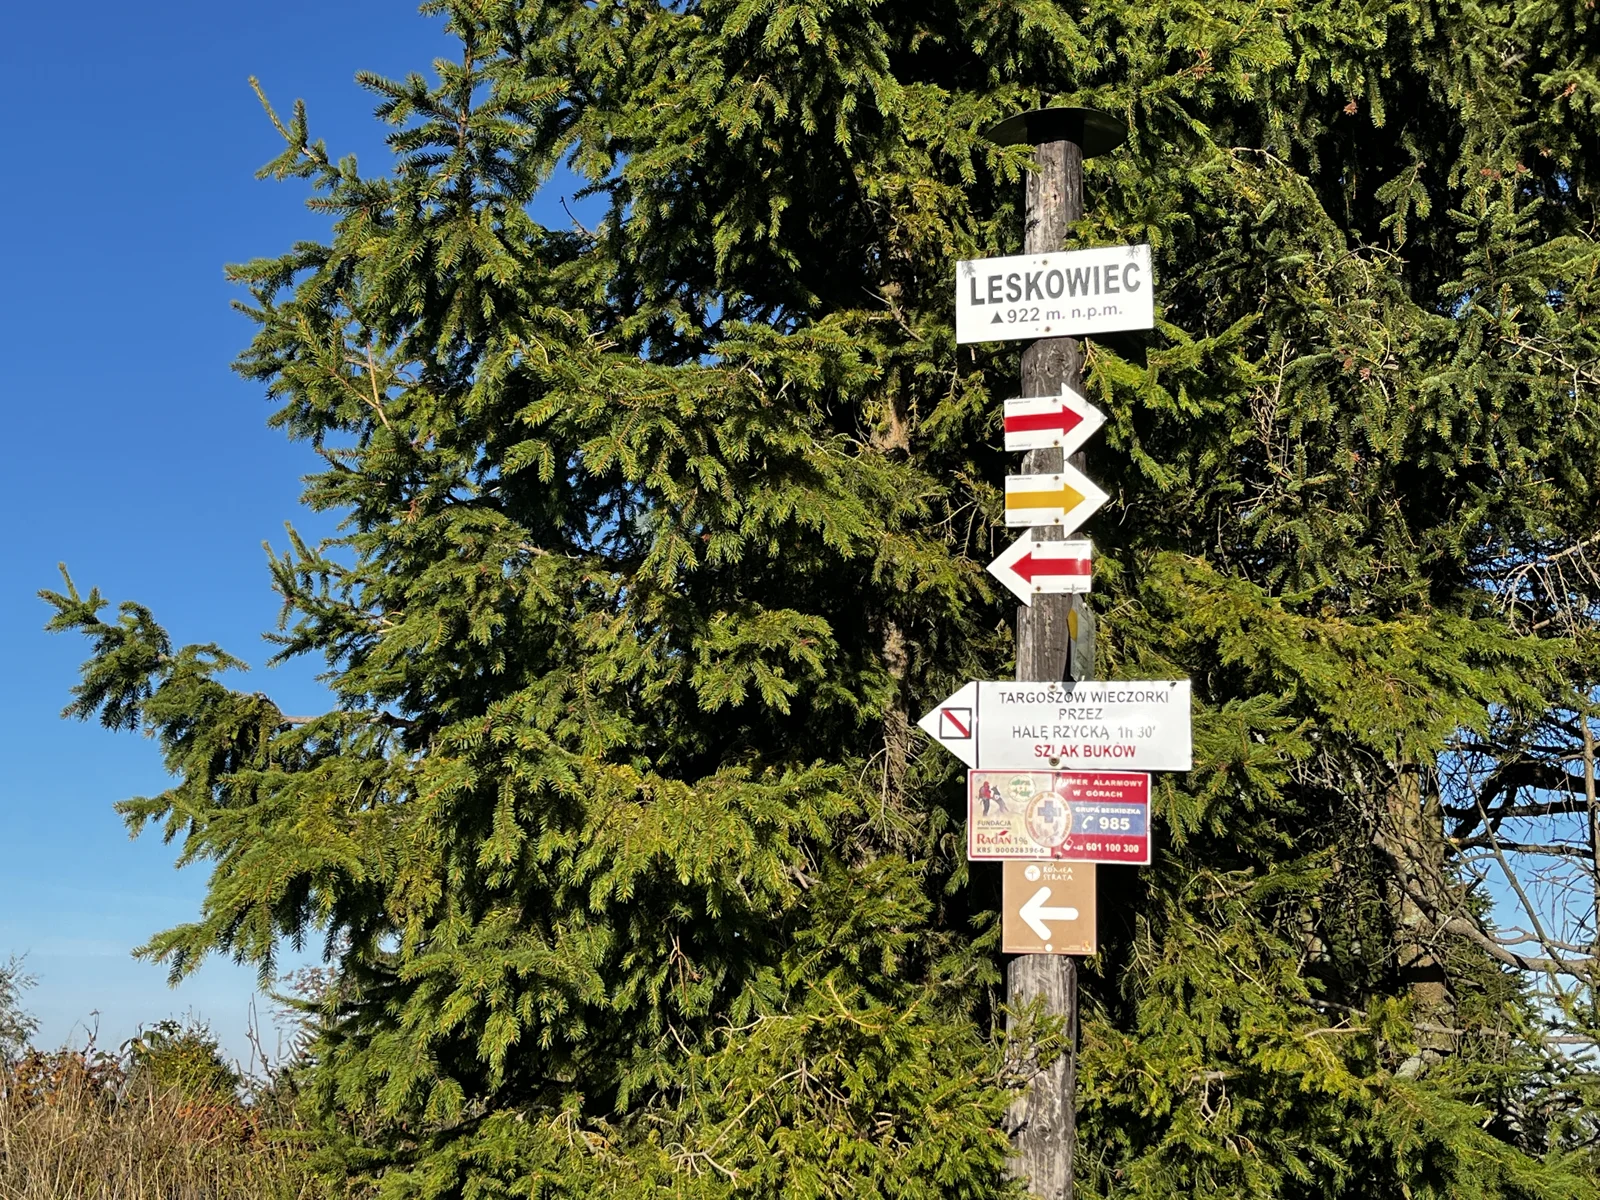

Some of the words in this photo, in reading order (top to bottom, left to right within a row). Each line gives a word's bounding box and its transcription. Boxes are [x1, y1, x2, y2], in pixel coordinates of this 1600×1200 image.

[970, 262, 1141, 306] LESKOWIEC
[1007, 307, 1040, 323] 922
[1046, 309, 1066, 320] m.
[1071, 304, 1123, 320] n.p.m.
[999, 690, 1087, 704] TARGOSZÓW
[1091, 691, 1169, 704] WIECZORKI
[1058, 708, 1103, 720] PRZEZ
[1012, 725, 1049, 740] HALĘ
[1053, 725, 1110, 740] RZYCKĄ
[1117, 725, 1133, 738] 1h
[1083, 742, 1136, 758] BUKÓW
[1057, 778, 1088, 786] UMER
[1093, 779, 1143, 787] ALARMOWY
[1072, 789, 1081, 797] W
[1085, 789, 1123, 798] GÓRACH
[1075, 806, 1100, 814] GRUPA
[1101, 807, 1141, 815] BESKIDZKA
[1099, 816, 1130, 831] 985
[1085, 842, 1102, 851] 601
[1105, 843, 1121, 852] 100
[1123, 844, 1139, 853] 300
